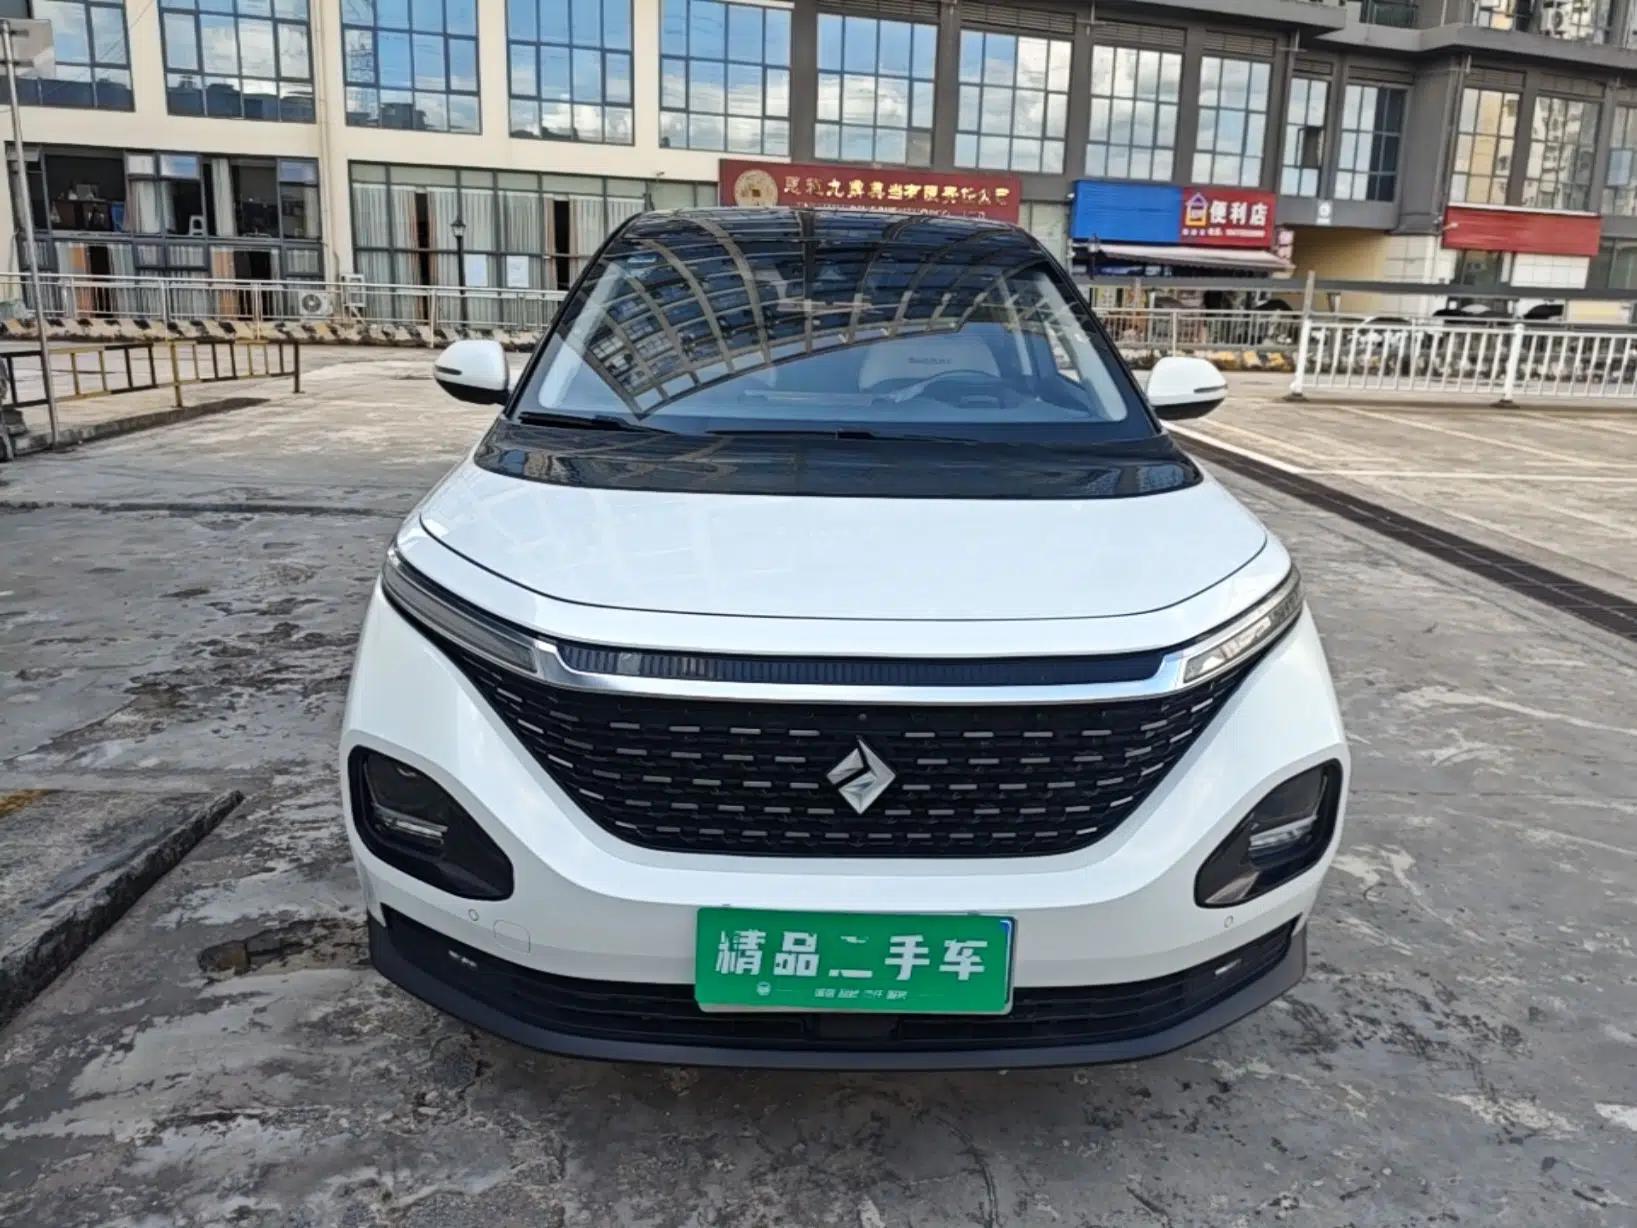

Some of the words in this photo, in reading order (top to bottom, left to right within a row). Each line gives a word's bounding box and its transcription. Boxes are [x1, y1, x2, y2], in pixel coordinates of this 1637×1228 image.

[1209, 199, 1268, 226] 便利店
[715, 929, 989, 982] 精品二手车
